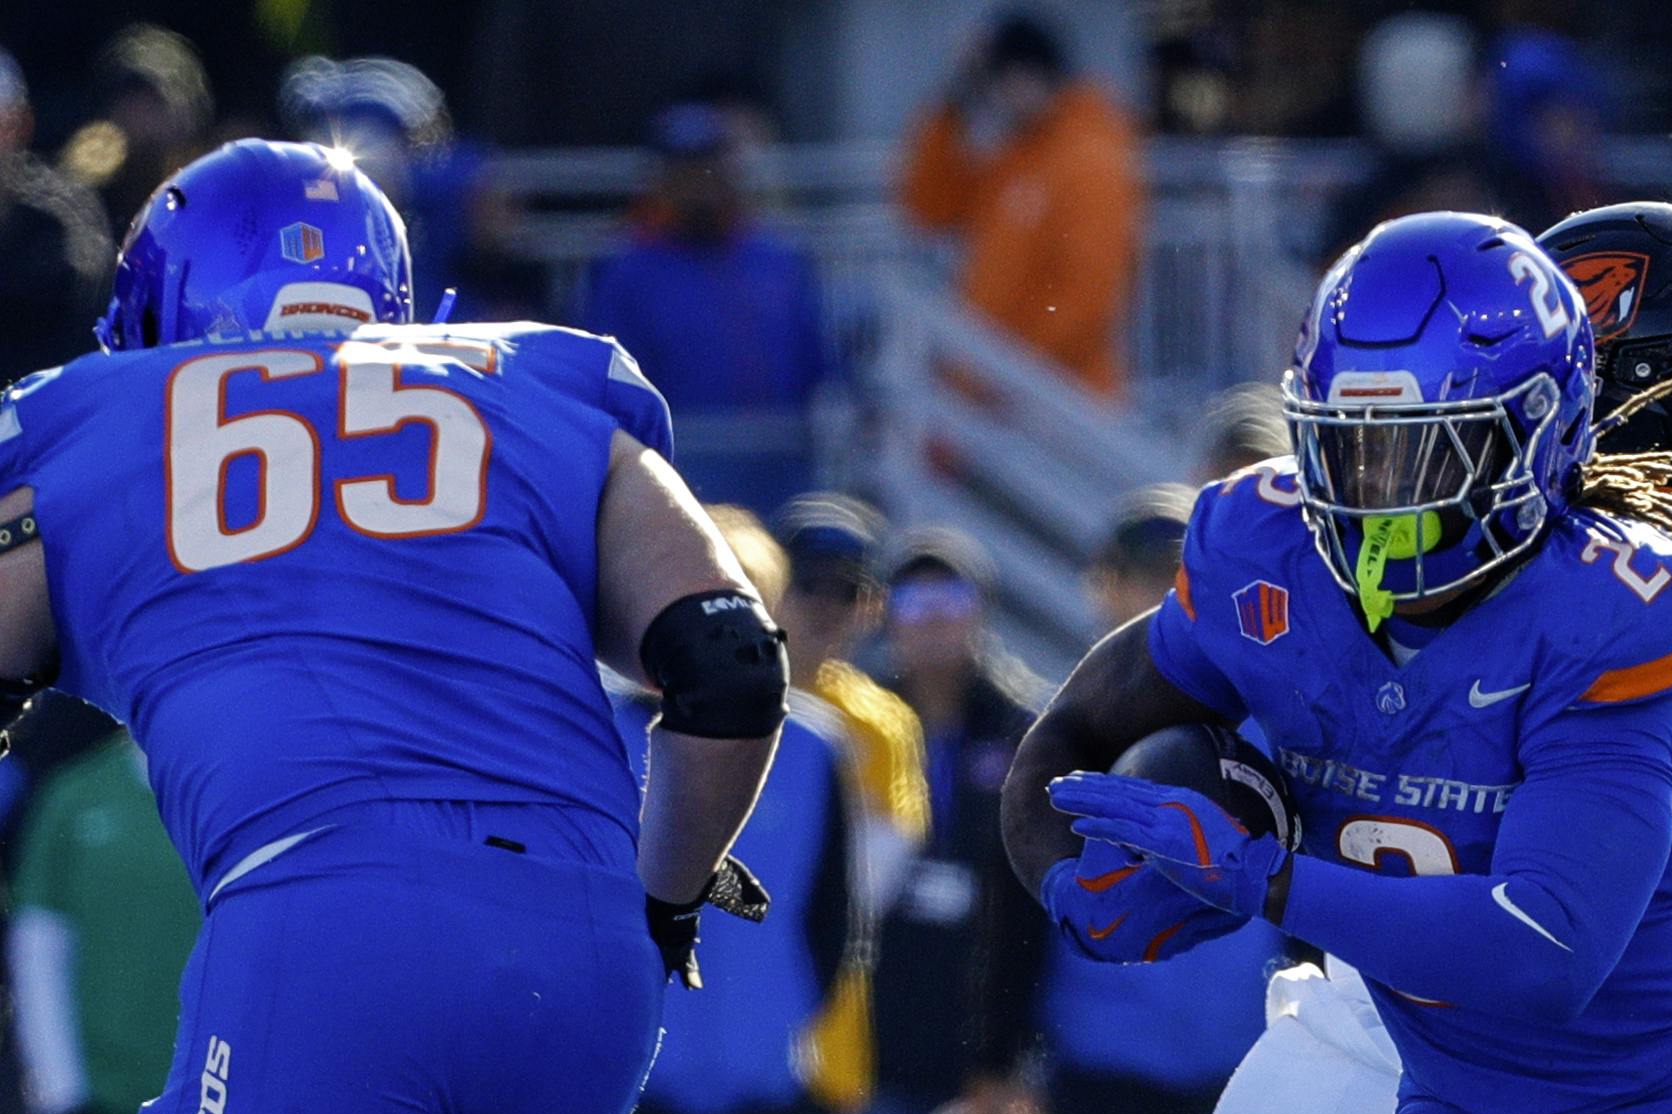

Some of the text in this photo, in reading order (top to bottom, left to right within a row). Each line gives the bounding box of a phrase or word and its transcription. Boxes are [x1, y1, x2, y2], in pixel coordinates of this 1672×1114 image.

[1508, 251, 1569, 338] 2
[164, 340, 496, 575] 65
[1279, 746, 1387, 803] BOISE
